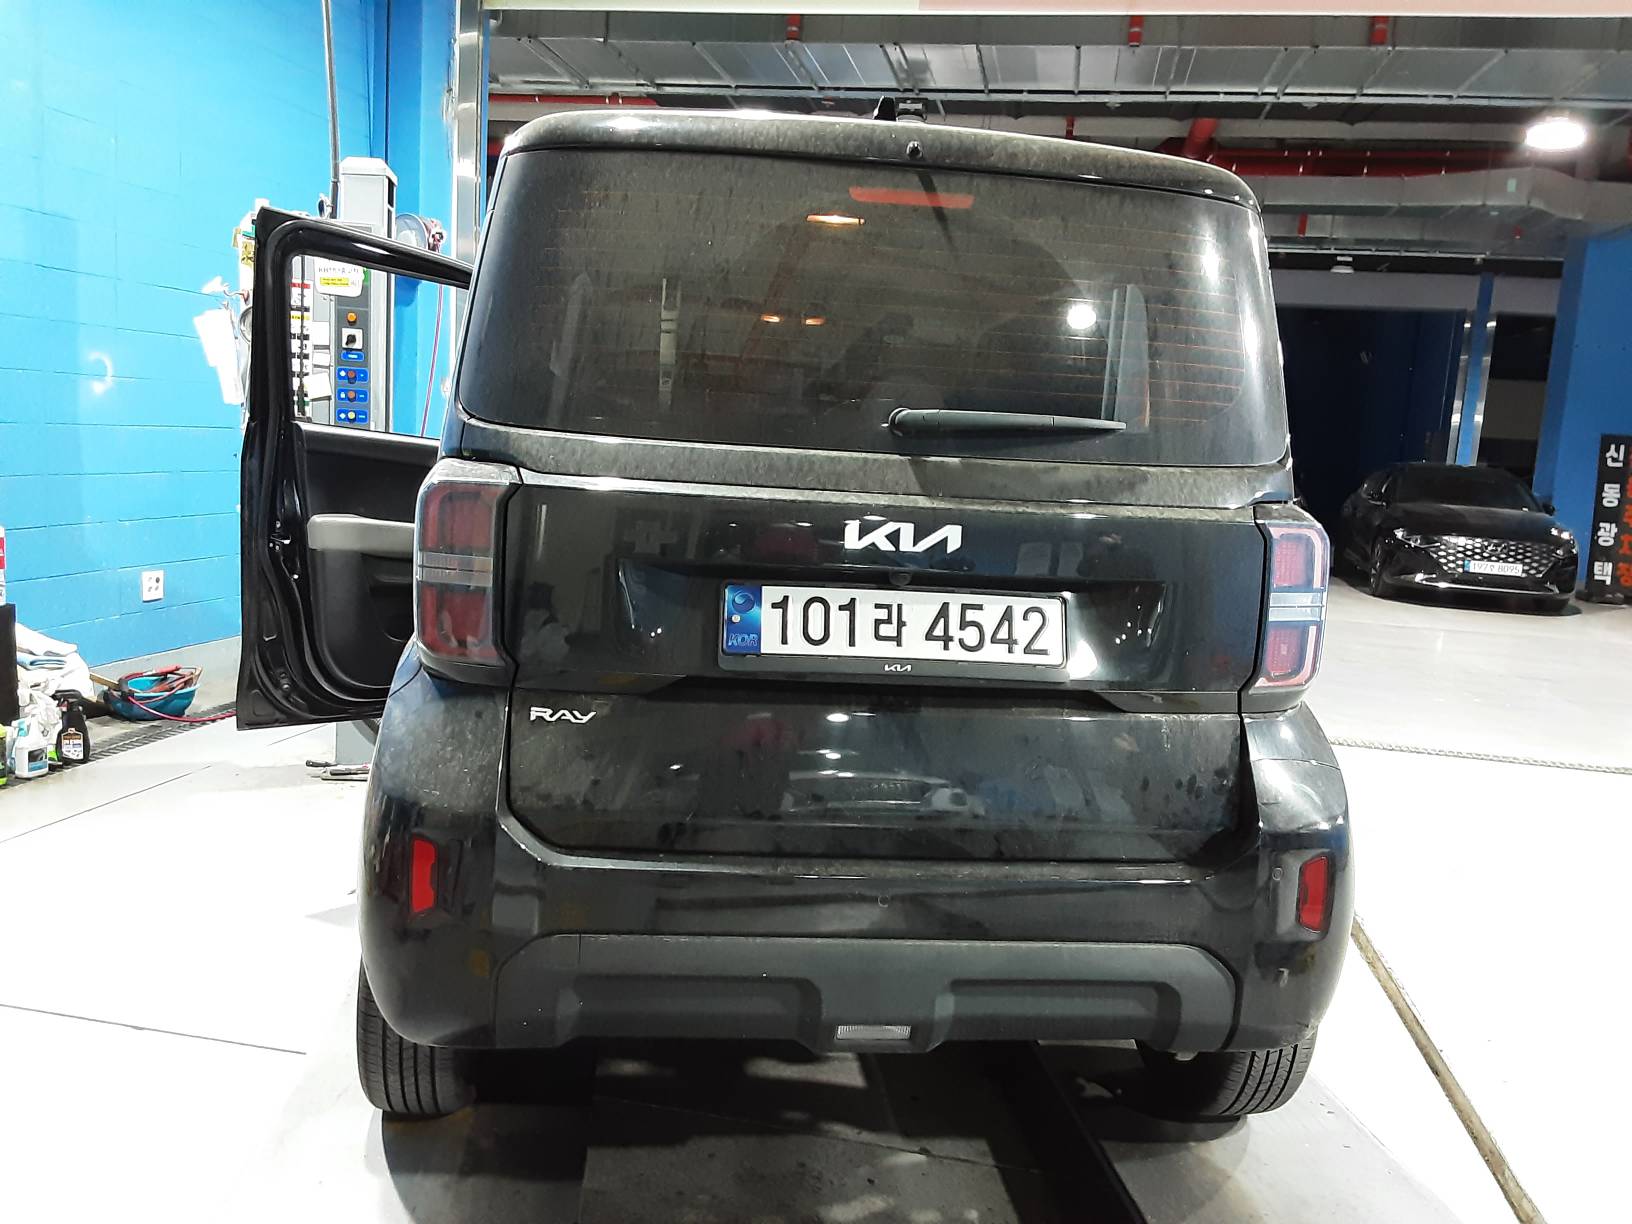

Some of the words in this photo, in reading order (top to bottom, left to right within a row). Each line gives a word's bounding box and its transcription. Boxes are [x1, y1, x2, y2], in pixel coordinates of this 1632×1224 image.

[844, 519, 962, 554] KIA
[770, 595, 907, 648] 101라
[924, 601, 1050, 656] 4542
[727, 632, 759, 647] KOR
[884, 663, 912, 673] KIA
[529, 706, 597, 724] RAY
